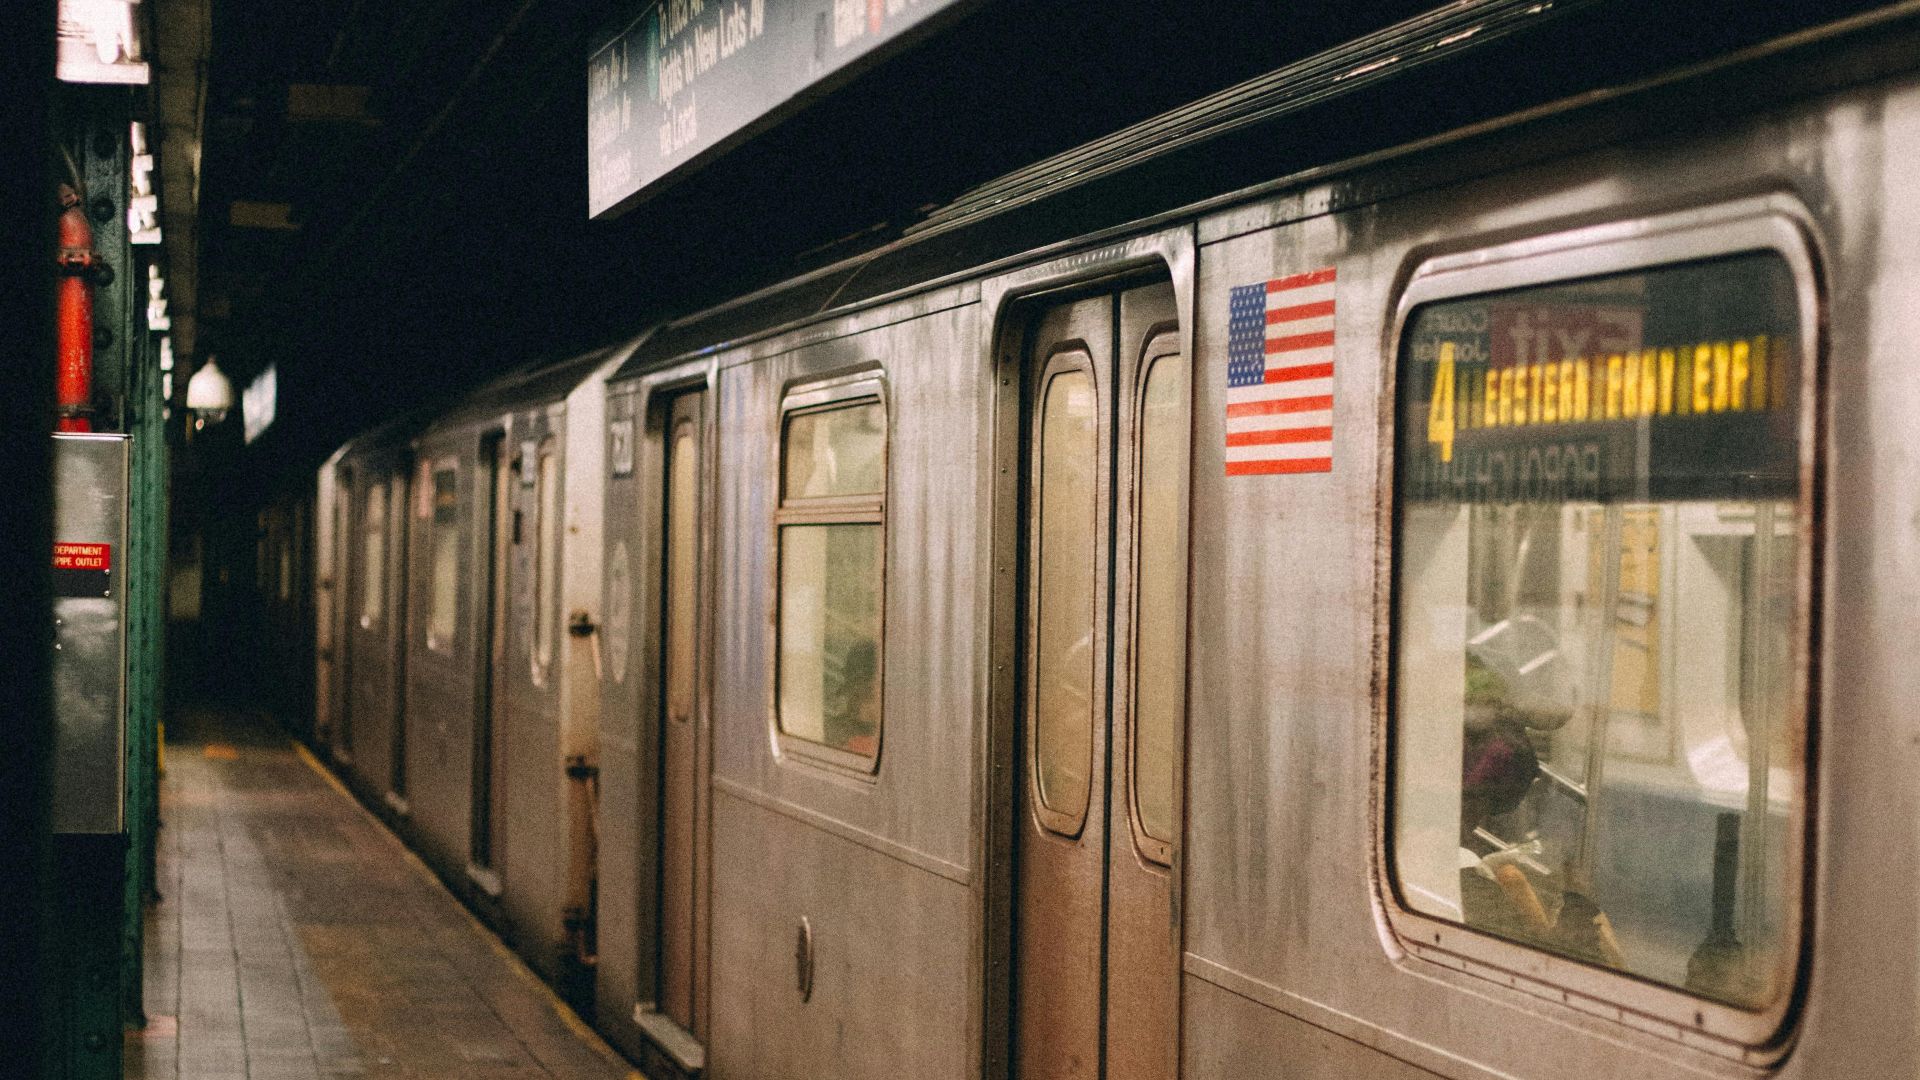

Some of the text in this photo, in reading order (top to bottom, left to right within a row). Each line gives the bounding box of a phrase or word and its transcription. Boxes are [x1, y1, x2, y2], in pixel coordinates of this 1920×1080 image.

[695, 25, 717, 75] New
[720, 1, 746, 60] Lots
[1428, 342, 1455, 462] 4
[54, 546, 102, 556] DEPARTMENT
[75, 557, 102, 567] OUTLET
